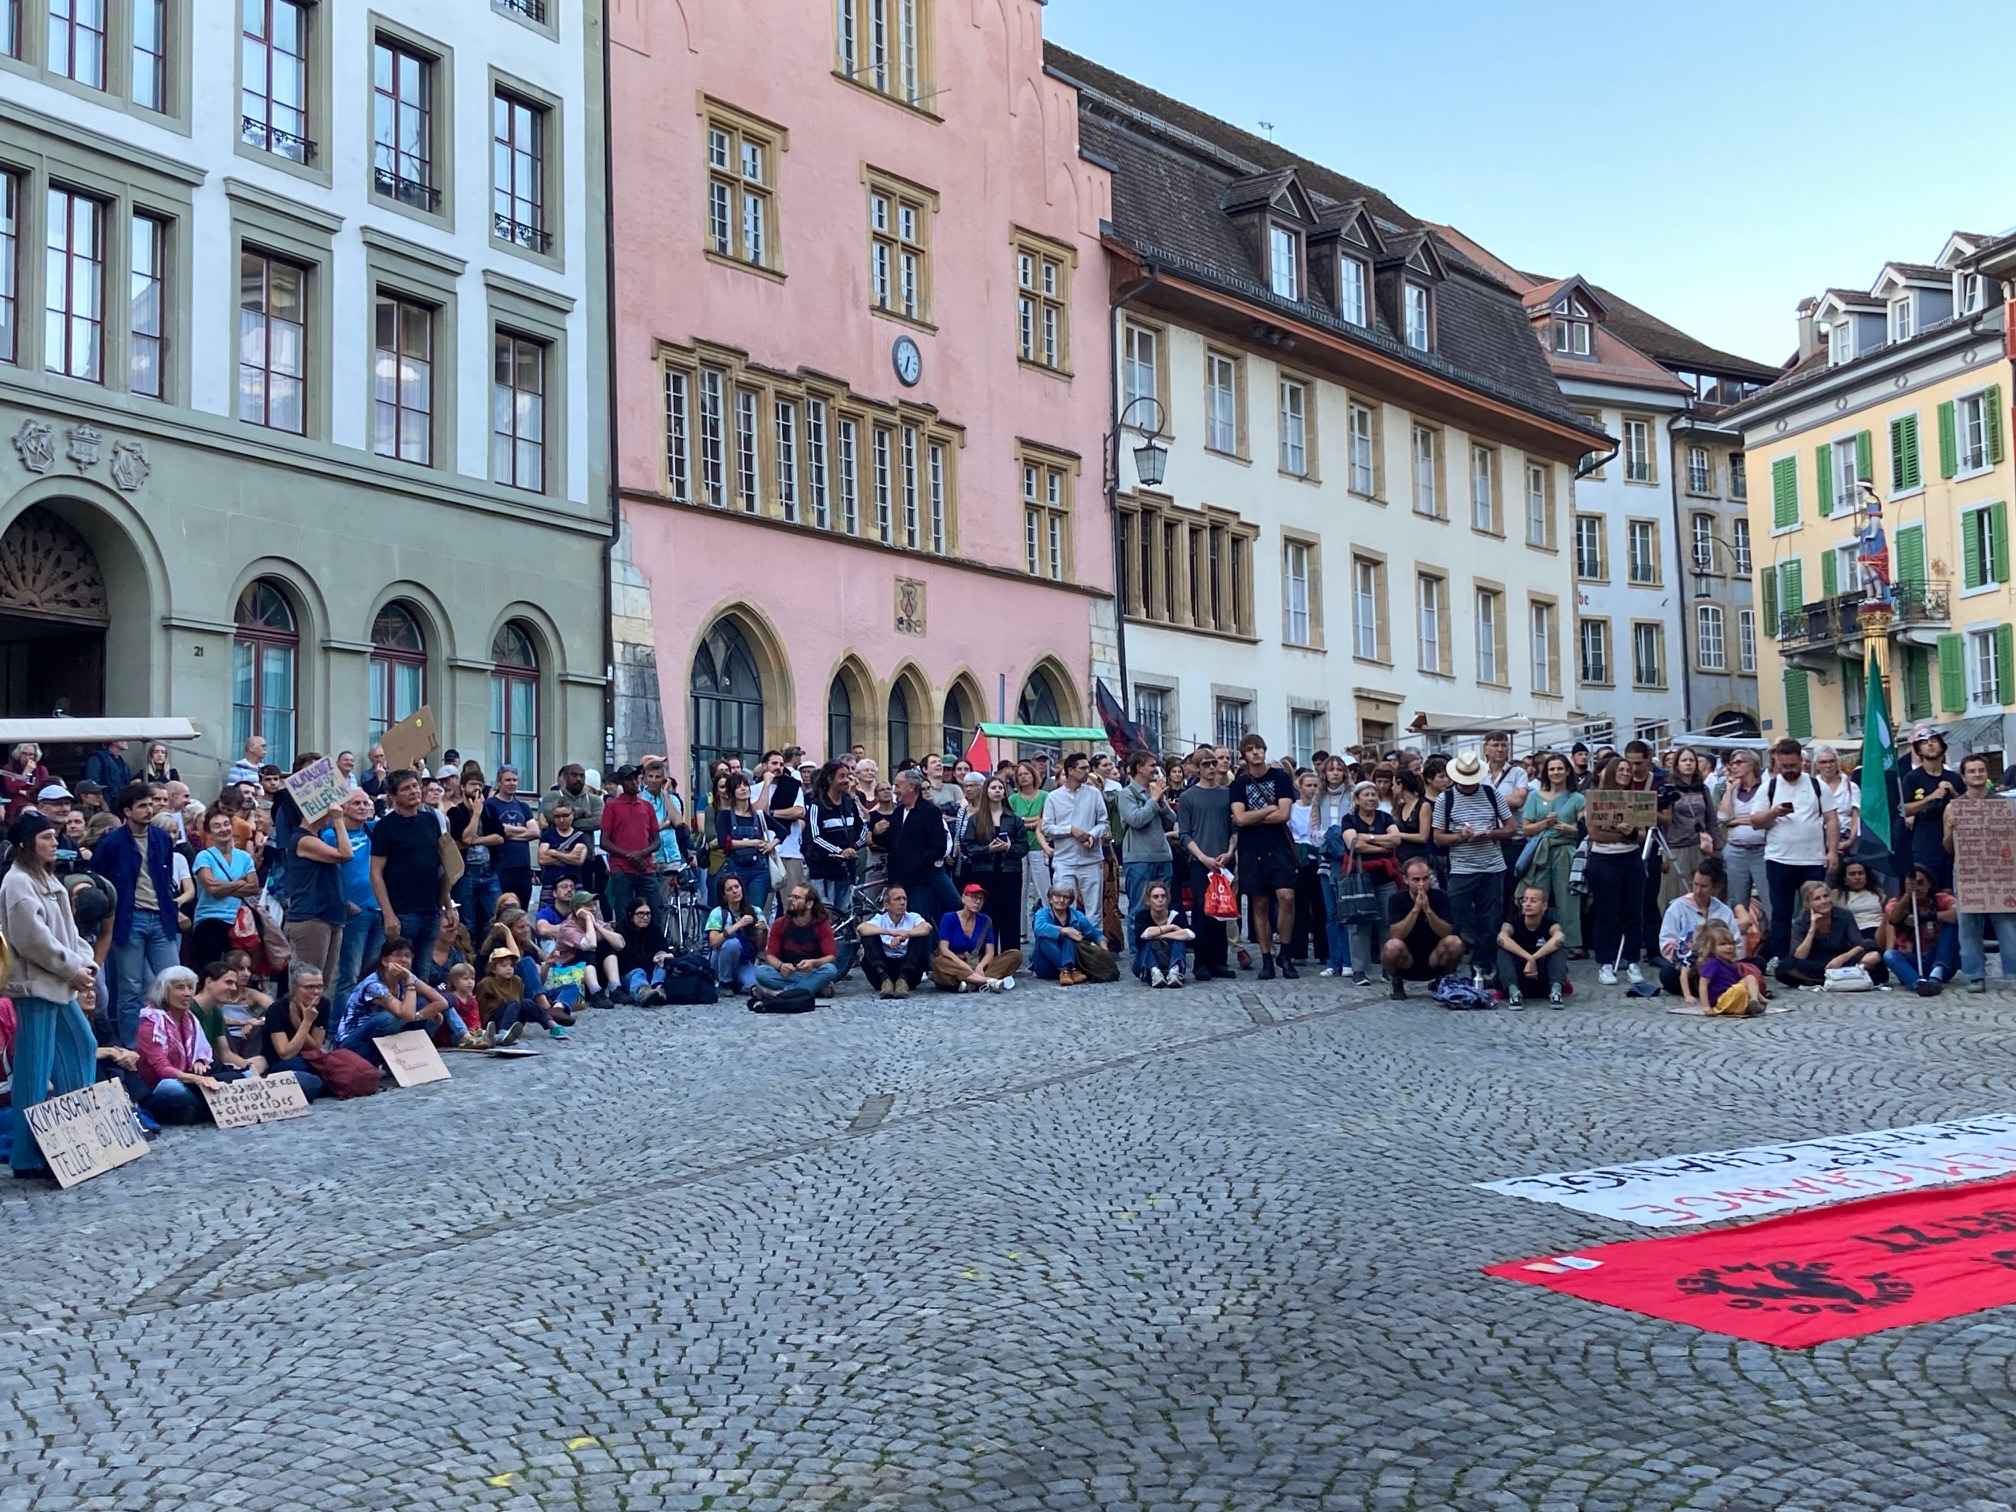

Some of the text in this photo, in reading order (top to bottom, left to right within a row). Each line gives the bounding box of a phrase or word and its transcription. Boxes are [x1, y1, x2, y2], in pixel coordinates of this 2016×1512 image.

[193, 645, 204, 657] 21
[288, 757, 335, 791] KLIMASCHUTZ
[300, 783, 350, 817] TELLER AN
[266, 1080, 279, 1089] DE
[27, 1086, 100, 1137] KLIMASCHUTZ
[215, 1109, 224, 1117] +
[94, 1122, 113, 1148] GO
[51, 1142, 97, 1179] TELLER
[1506, 1150, 1797, 1196] CHANGE
[1619, 1169, 1914, 1223] CHANGE
